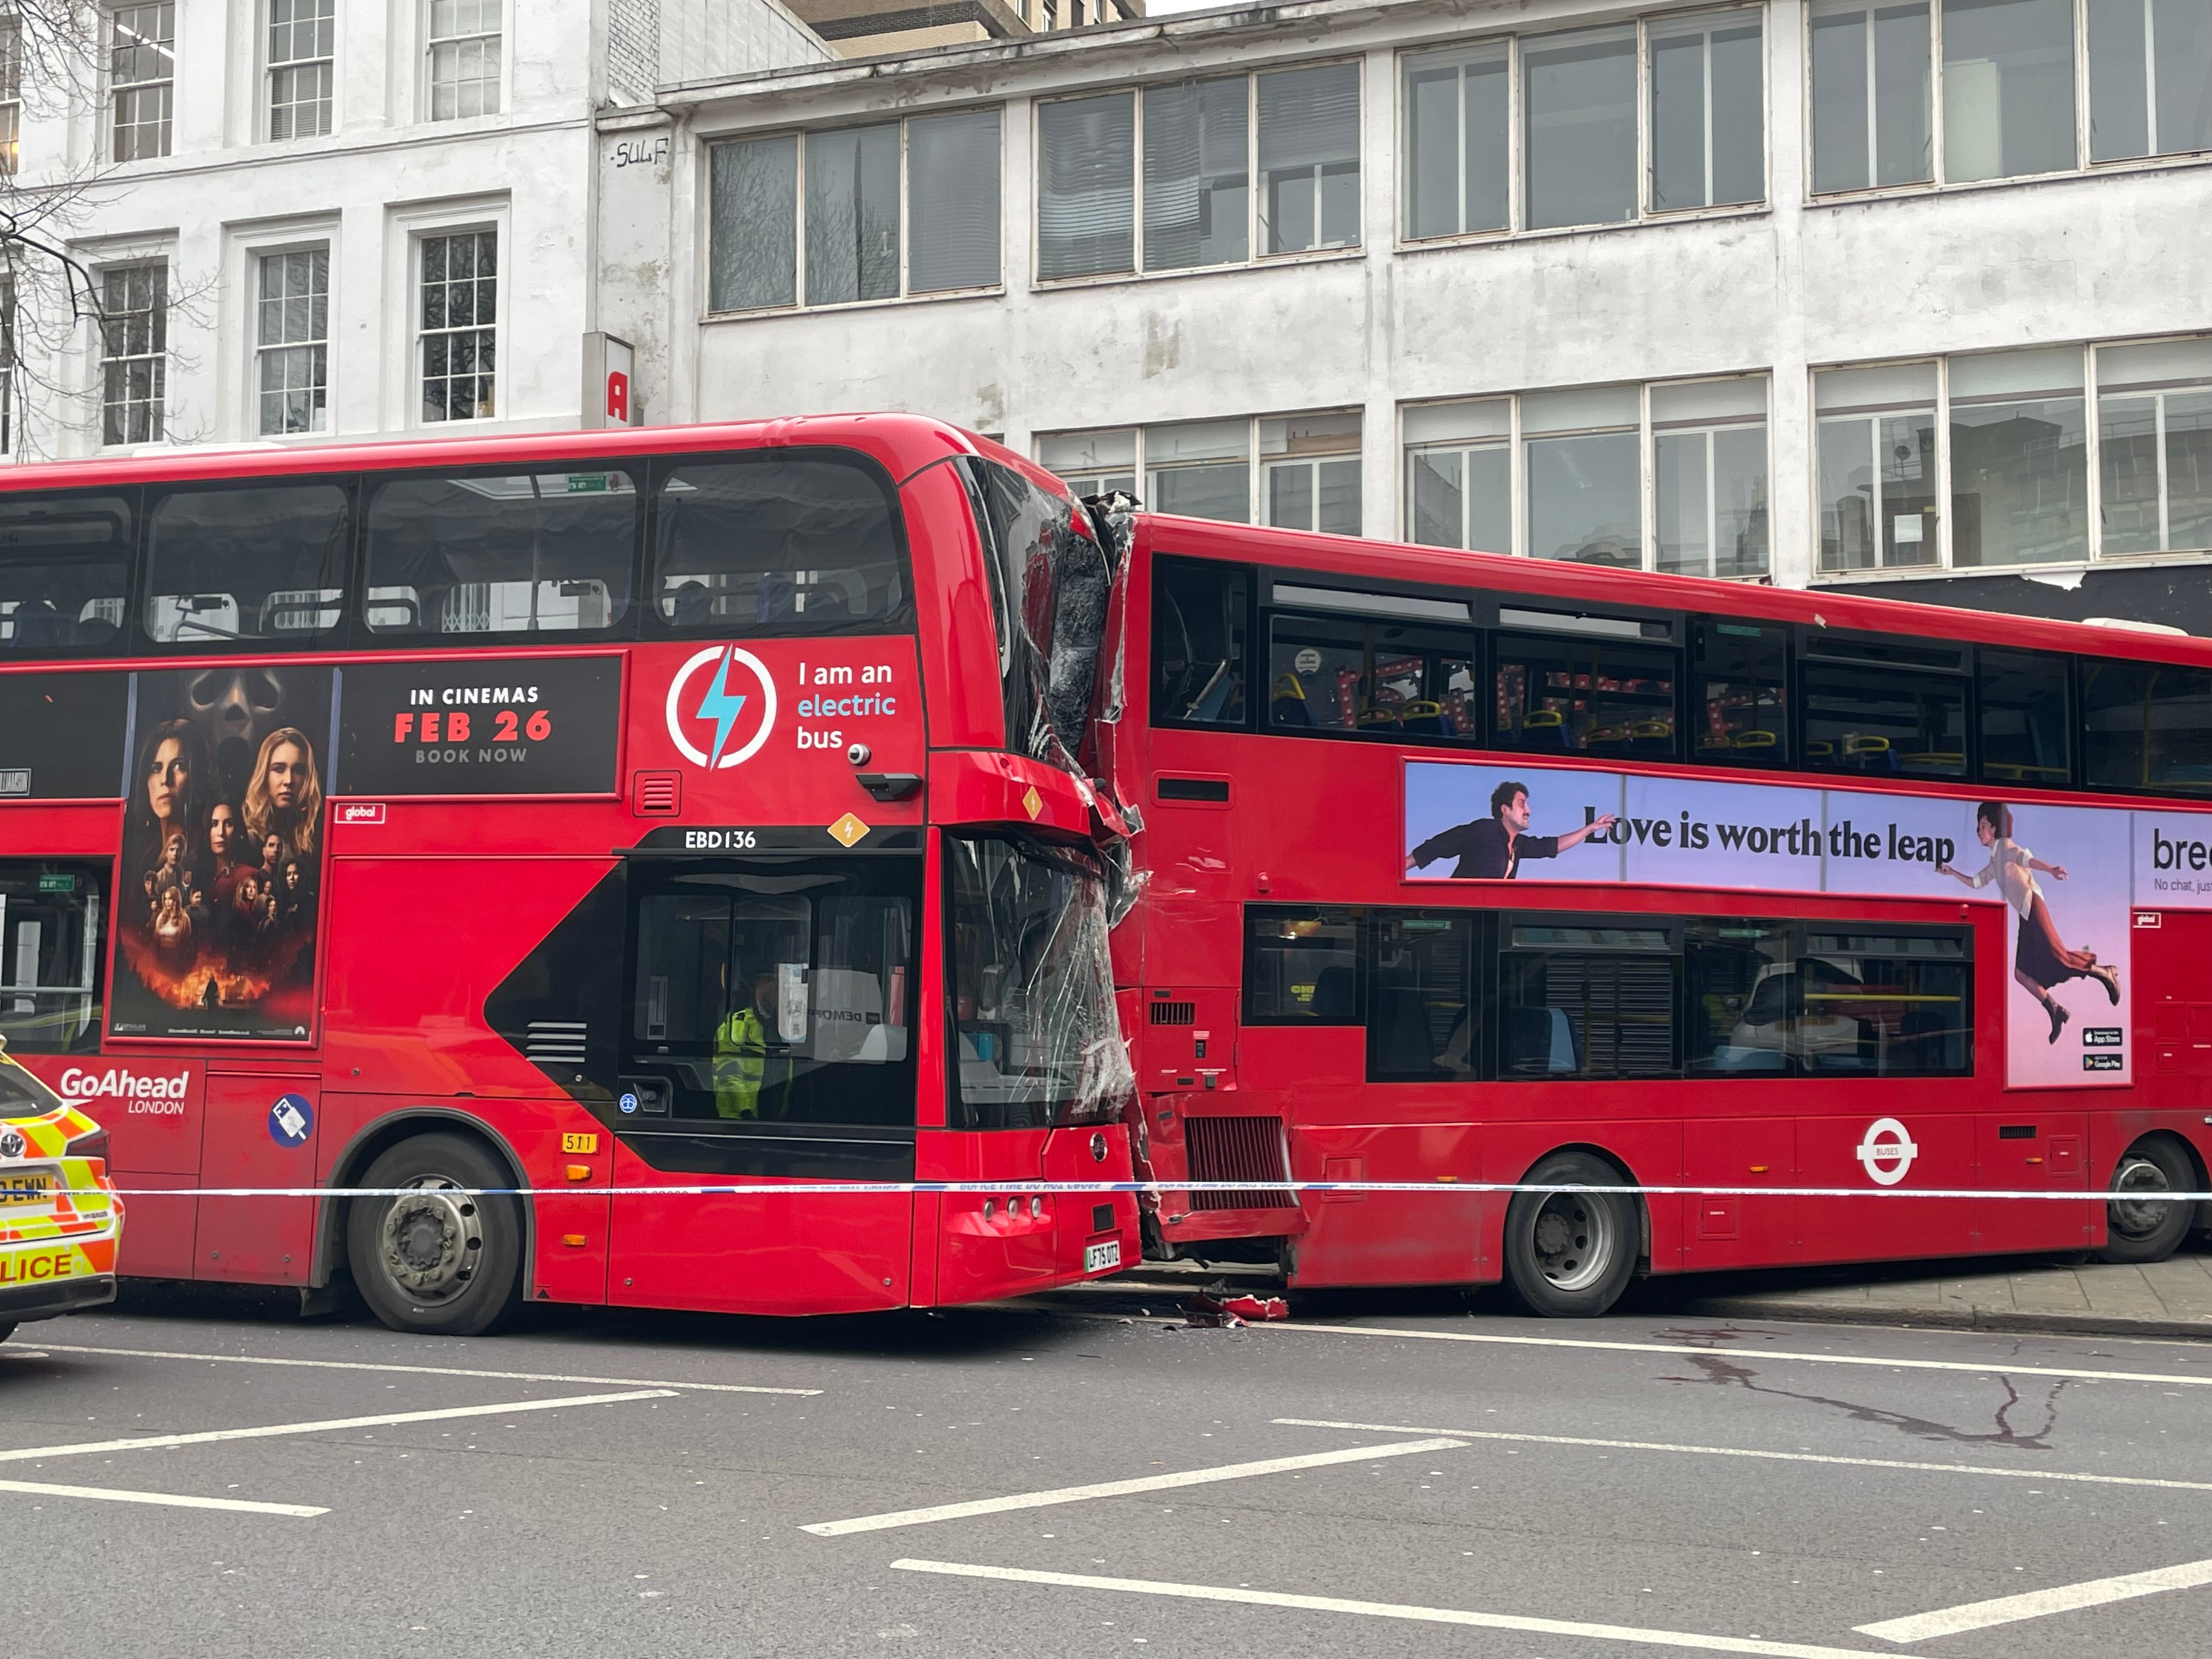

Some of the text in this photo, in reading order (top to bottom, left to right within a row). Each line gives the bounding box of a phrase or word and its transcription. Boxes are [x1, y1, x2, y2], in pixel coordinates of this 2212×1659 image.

[607, 371, 628, 422] A
[799, 662, 892, 685] I am an
[410, 686, 539, 705] IN CINEMAS
[797, 692, 896, 717] electric
[394, 709, 552, 743] FEB 26
[796, 726, 843, 749] bus
[415, 748, 527, 763] BOOK NOW
[345, 805, 376, 821] global
[685, 830, 756, 849] EBD136
[1584, 806, 1955, 872] Love is worth the leap
[2154, 828, 2212, 871] bre
[2154, 878, 2168, 890] No
[2196, 879, 2212, 895] jus
[60, 1068, 190, 1099] GoAhead
[128, 1100, 184, 1115] LONDON
[566, 1135, 590, 1150] 511
[1876, 1147, 1899, 1156] BUSES
